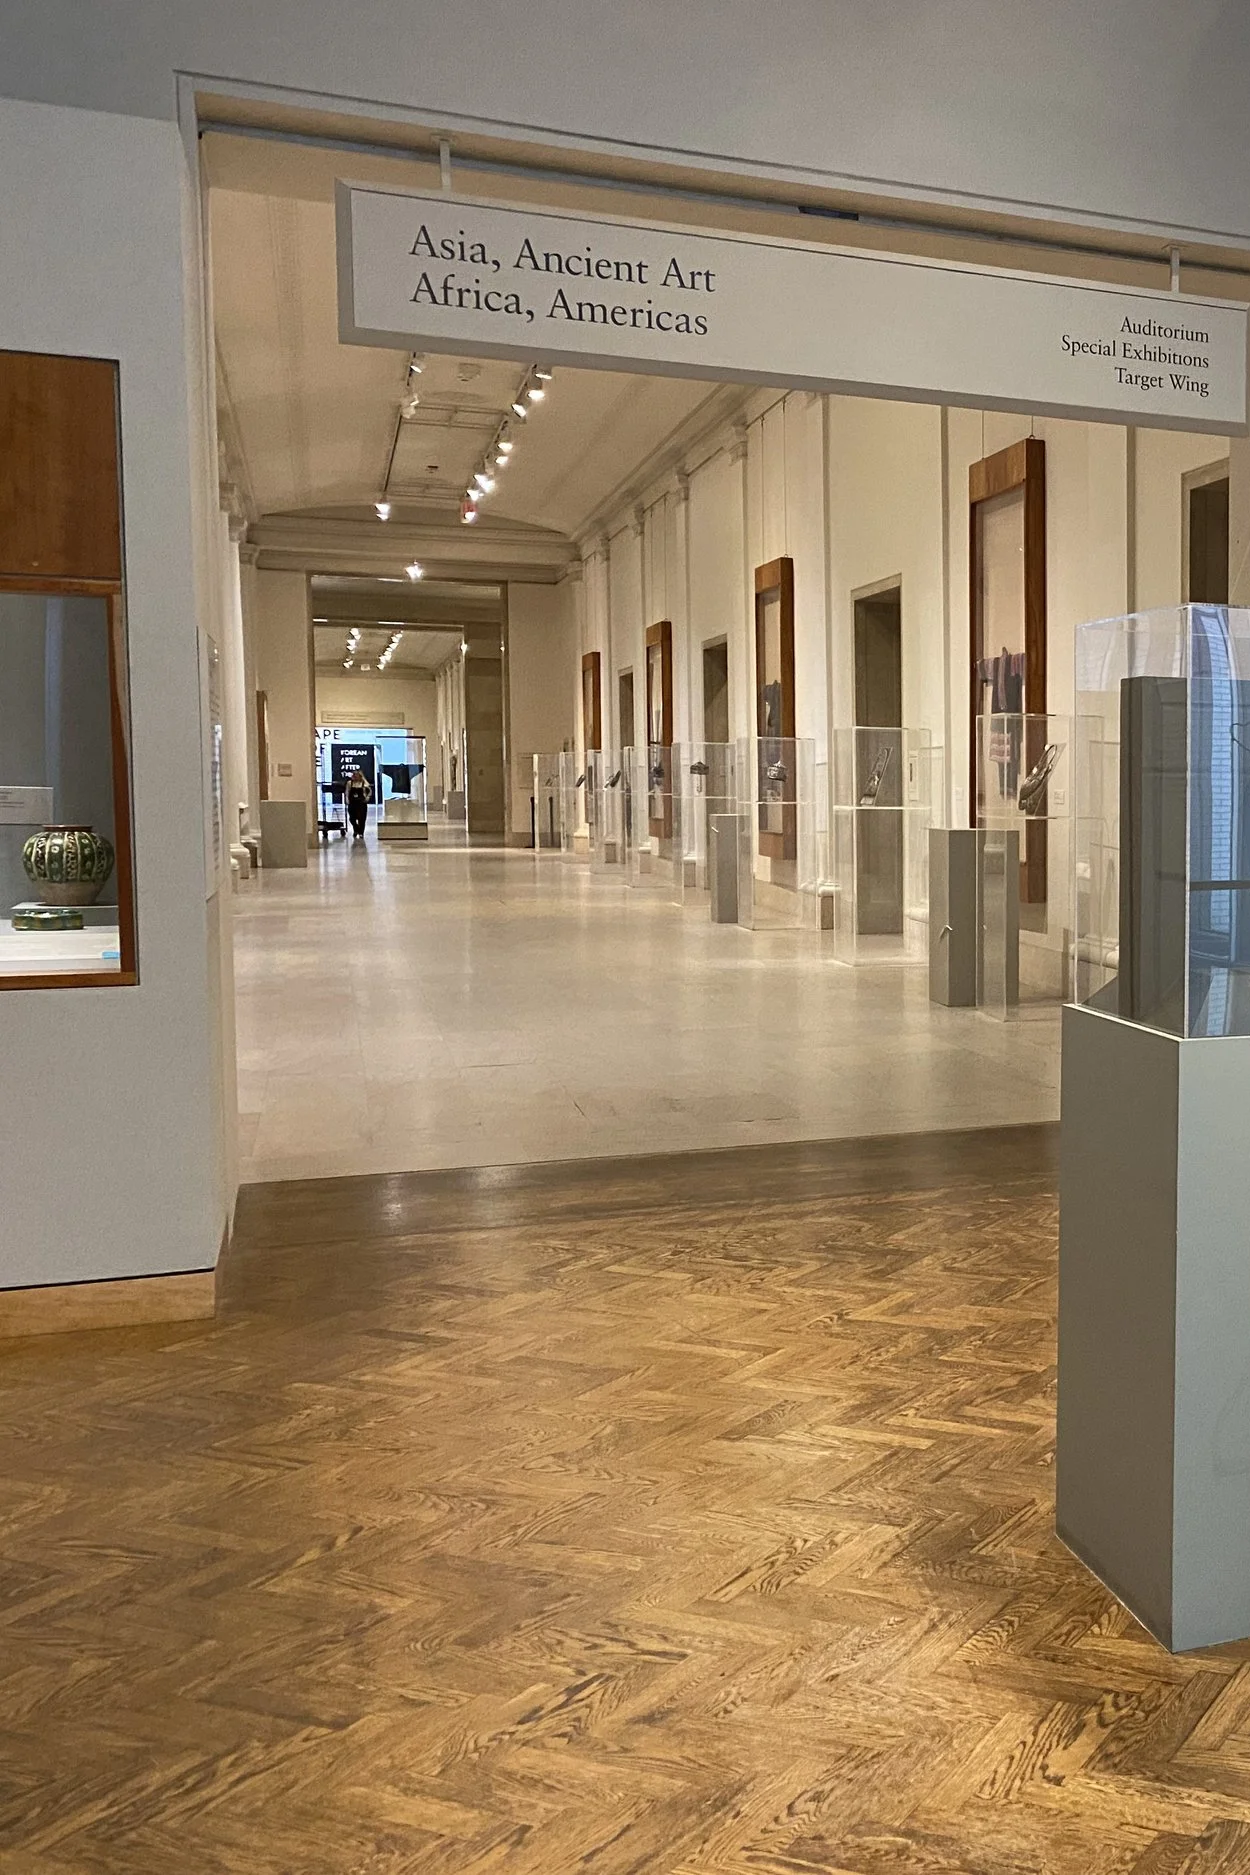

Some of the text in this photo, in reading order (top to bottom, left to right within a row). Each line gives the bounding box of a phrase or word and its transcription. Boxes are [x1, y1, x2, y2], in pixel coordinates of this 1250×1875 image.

[408, 224, 717, 293] Asia, Ancient Art
[409, 271, 709, 336] Africa, Americas
[1120, 315, 1210, 343] Auditorium
[1061, 334, 1210, 369] Special Exhibitions
[1114, 366, 1210, 398] Target Wing
